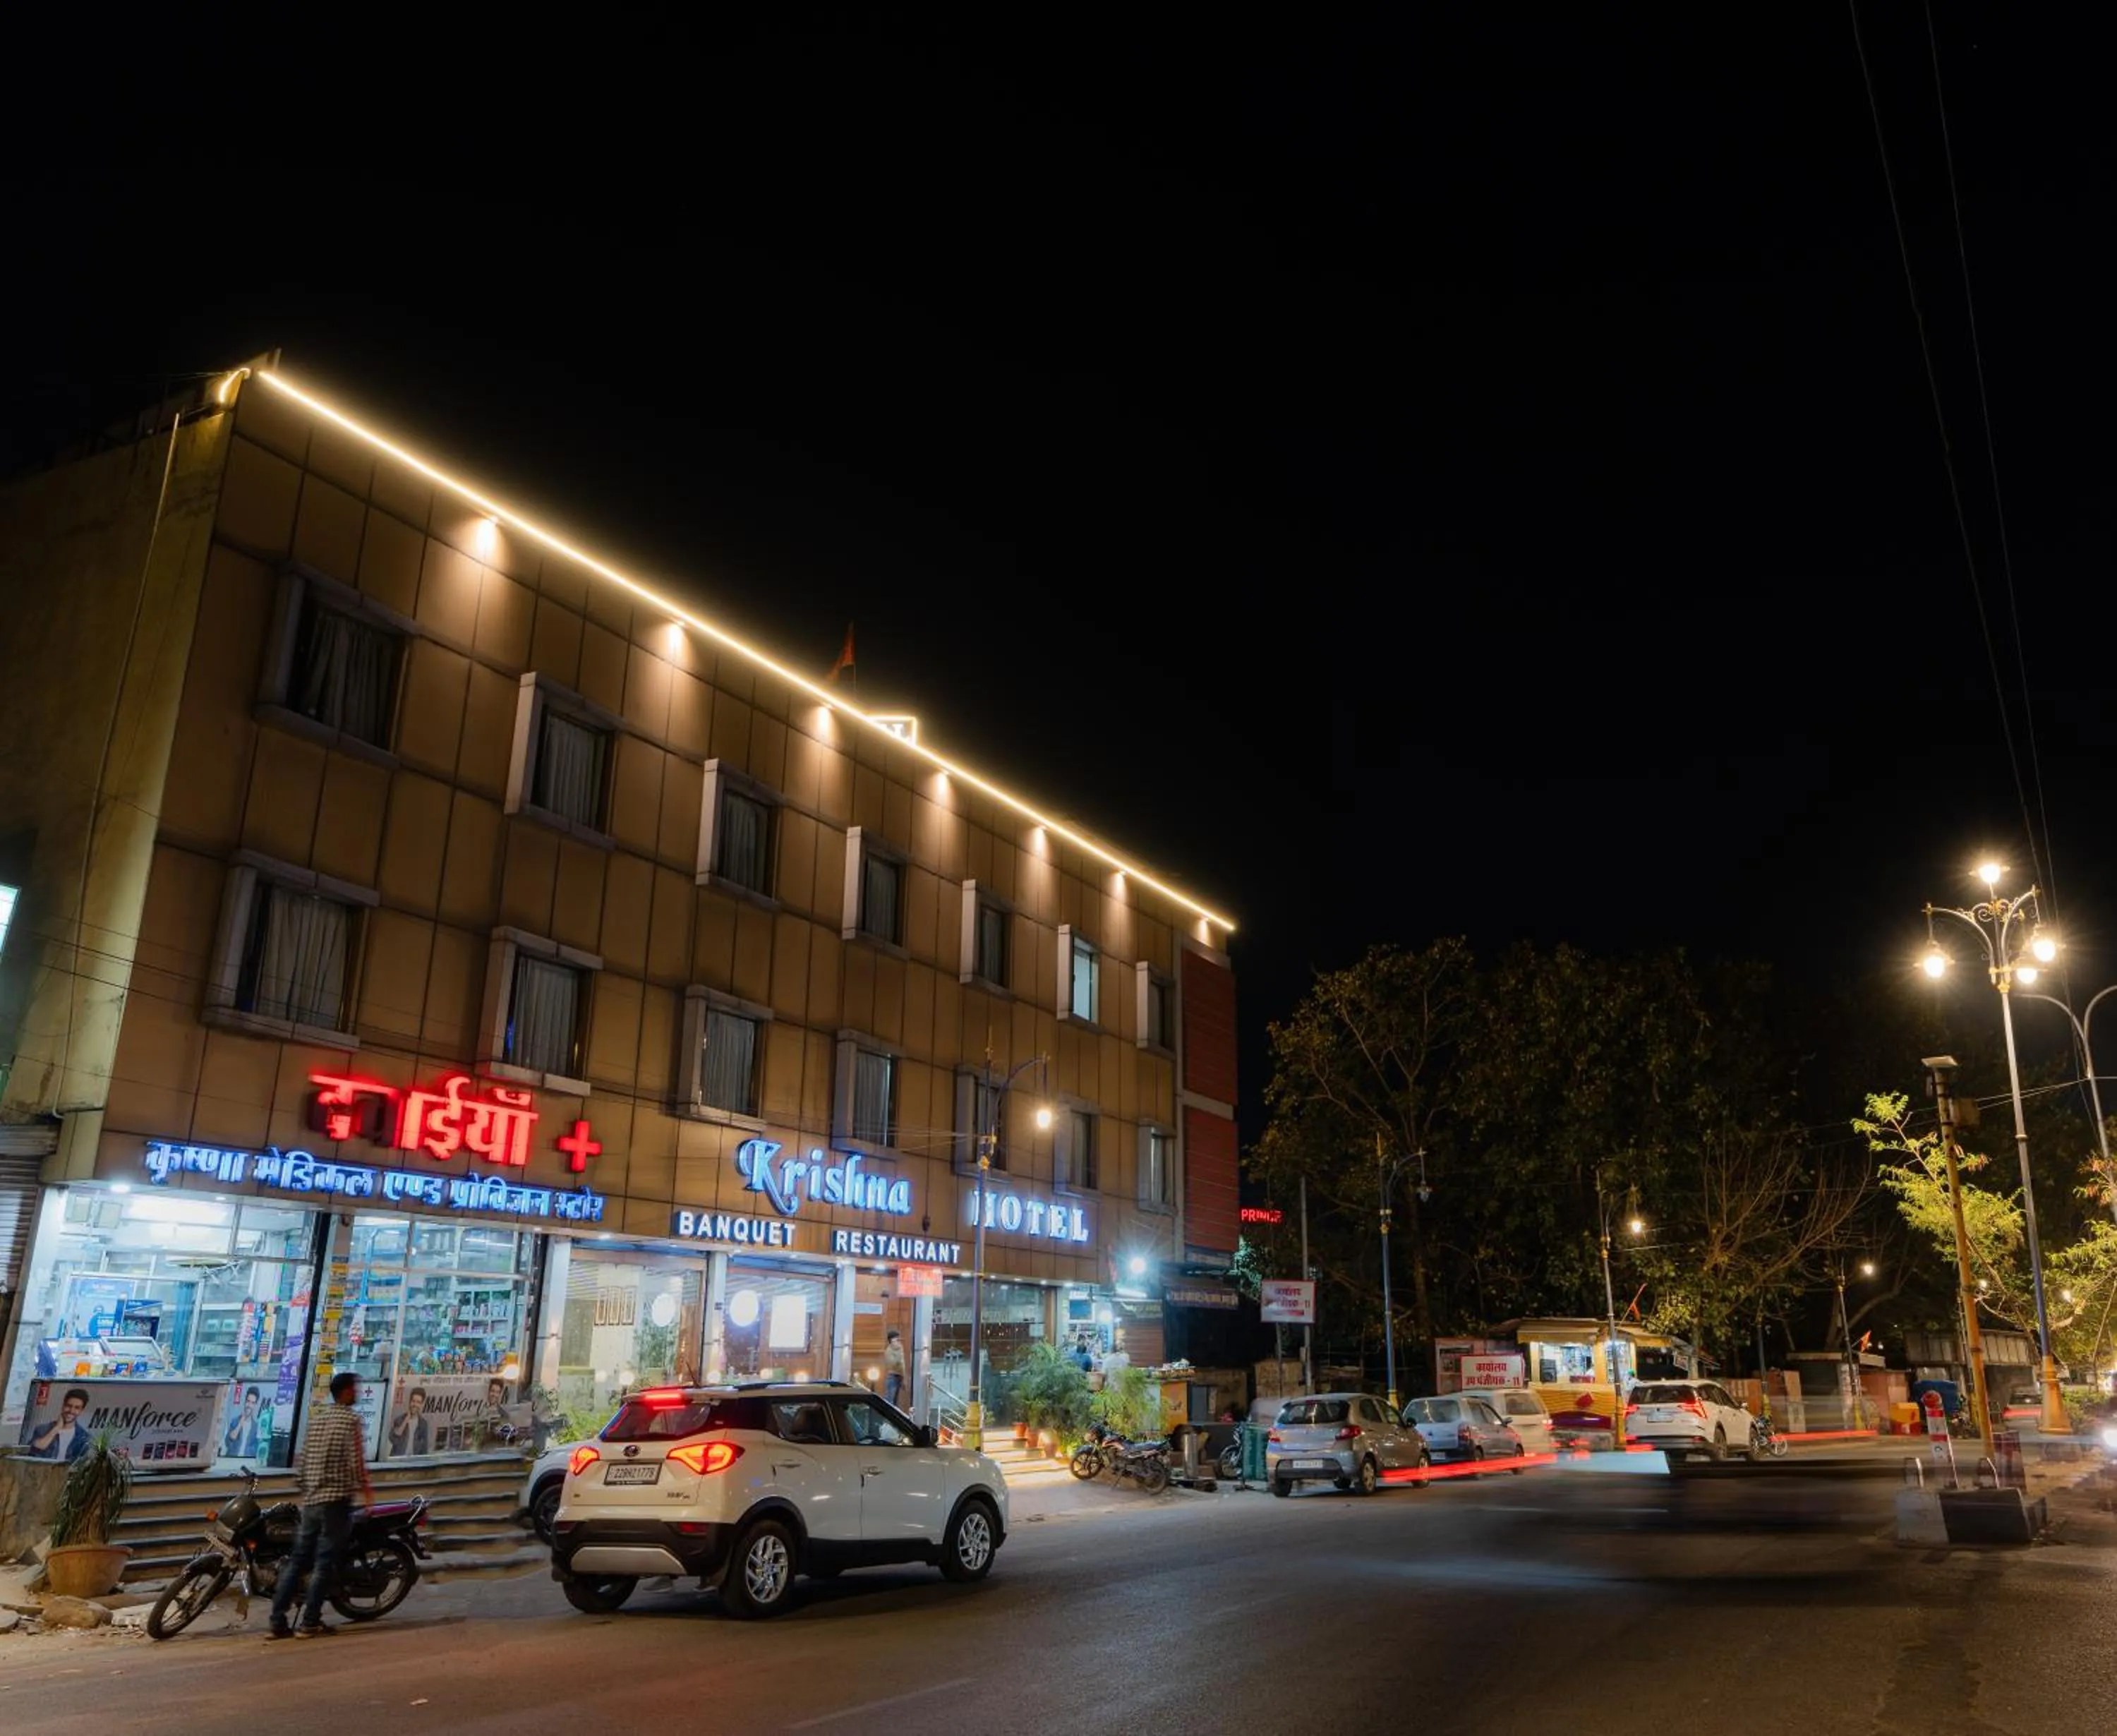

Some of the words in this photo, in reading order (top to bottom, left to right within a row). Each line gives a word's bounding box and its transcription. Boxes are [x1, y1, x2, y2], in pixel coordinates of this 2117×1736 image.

[145, 1140, 249, 1186] कृष्णा
[253, 1145, 378, 1197] मेडिकल
[737, 1138, 911, 1216] Krishna
[679, 1210, 796, 1246] BANQUET
[836, 1230, 960, 1265] RESTAURANT
[88, 1401, 198, 1440] MANforce
